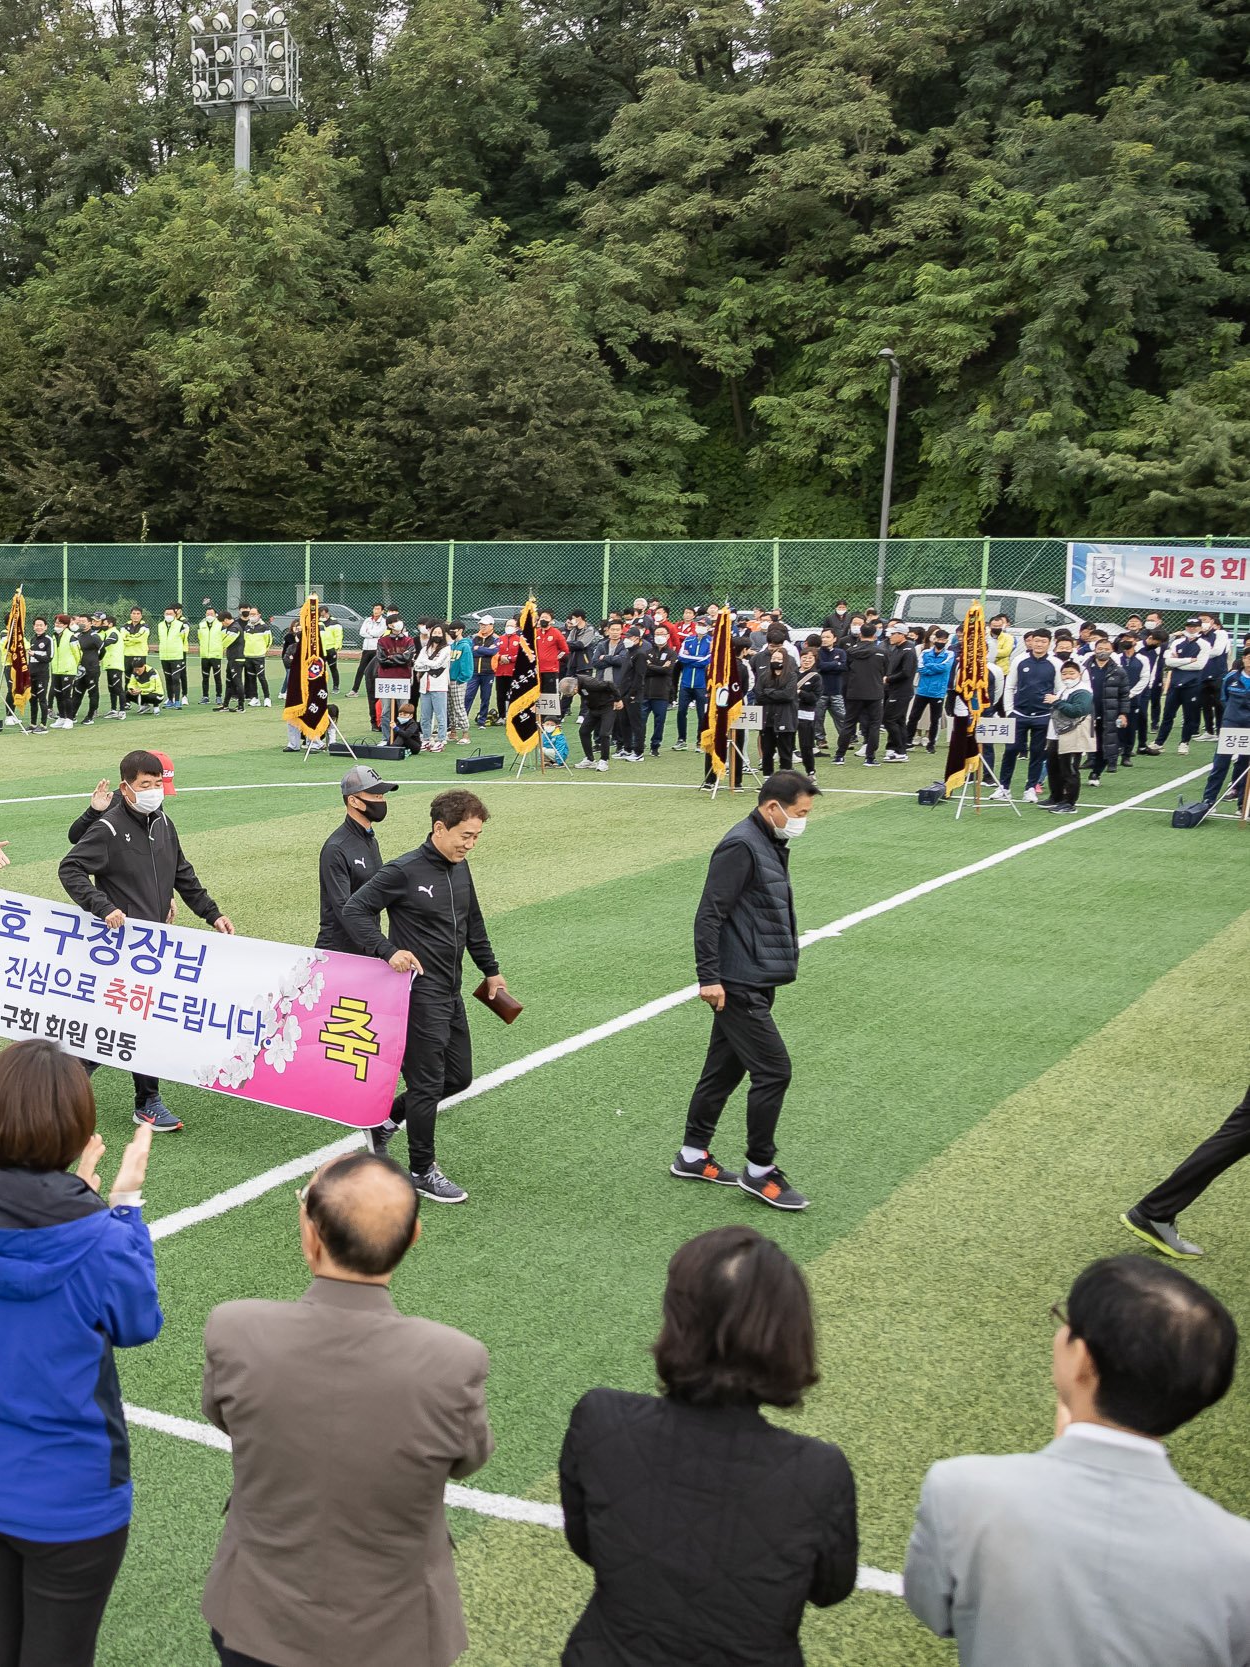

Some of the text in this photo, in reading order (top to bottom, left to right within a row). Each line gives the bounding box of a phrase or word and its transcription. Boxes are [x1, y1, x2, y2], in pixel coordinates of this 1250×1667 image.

[1149, 556, 1247, 581] 제26회
[378, 683, 409, 694] 광장축구회
[44, 910, 207, 984] 구청장님
[5, 956, 97, 1004] 진심으로
[103, 977, 271, 1047] 축하드립니다.
[45, 1014, 88, 1049] 회원
[95, 1026, 137, 1062] 일동
[319, 995, 380, 1082] 축
